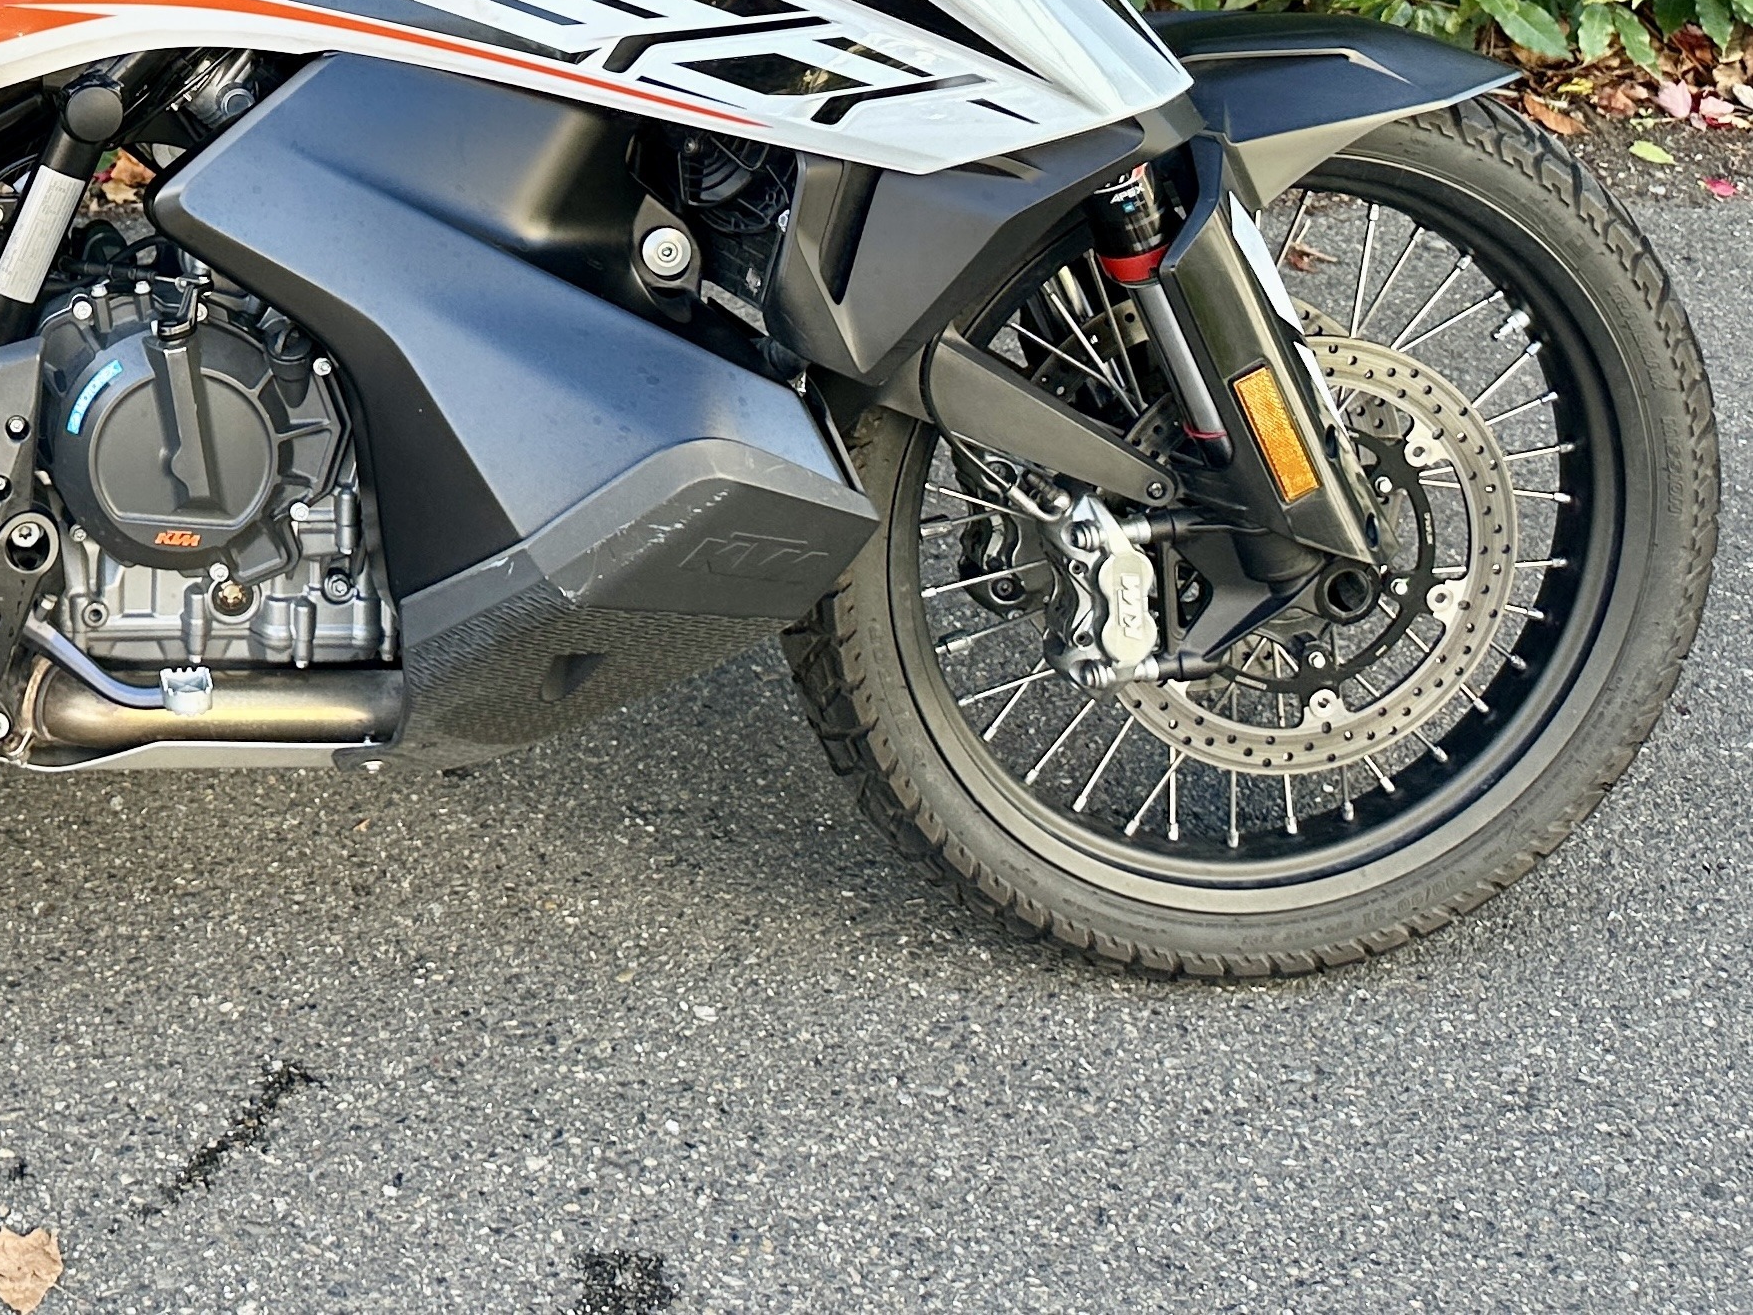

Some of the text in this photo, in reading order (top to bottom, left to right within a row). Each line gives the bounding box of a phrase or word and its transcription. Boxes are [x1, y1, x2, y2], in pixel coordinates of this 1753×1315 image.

[1659, 416, 1684, 515] MISSION
[155, 530, 201, 547] KTM
[1116, 572, 1143, 642] KTM
